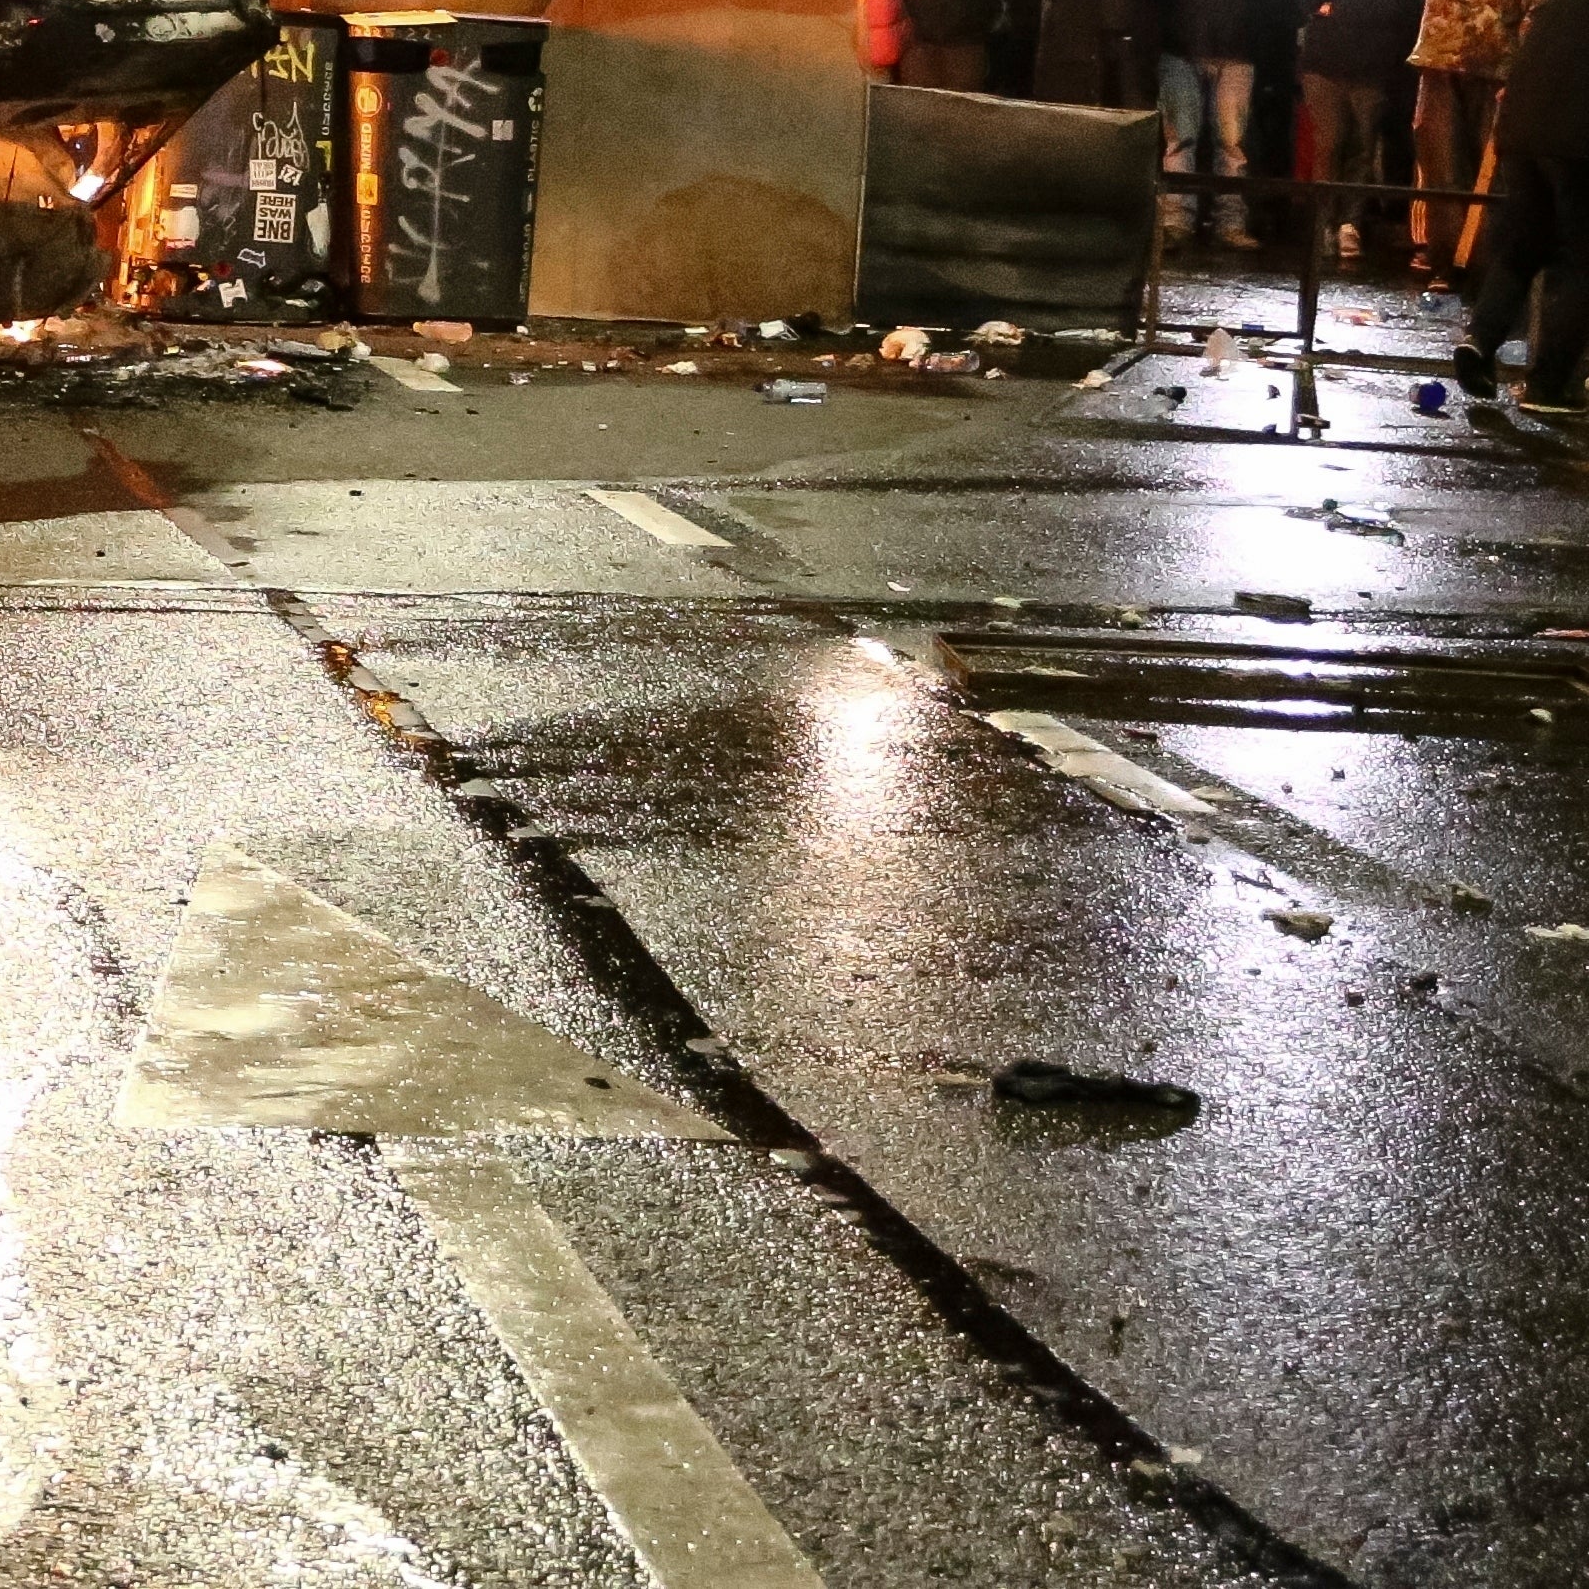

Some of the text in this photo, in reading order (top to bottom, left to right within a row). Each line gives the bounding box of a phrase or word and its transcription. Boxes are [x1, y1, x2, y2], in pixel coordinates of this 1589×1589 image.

[360, 122, 372, 173] MIXED
[527, 120, 541, 182] PLASTIC
[259, 195, 294, 208] HERE
[259, 208, 292, 219] WAS
[256, 219, 291, 241] BNE
